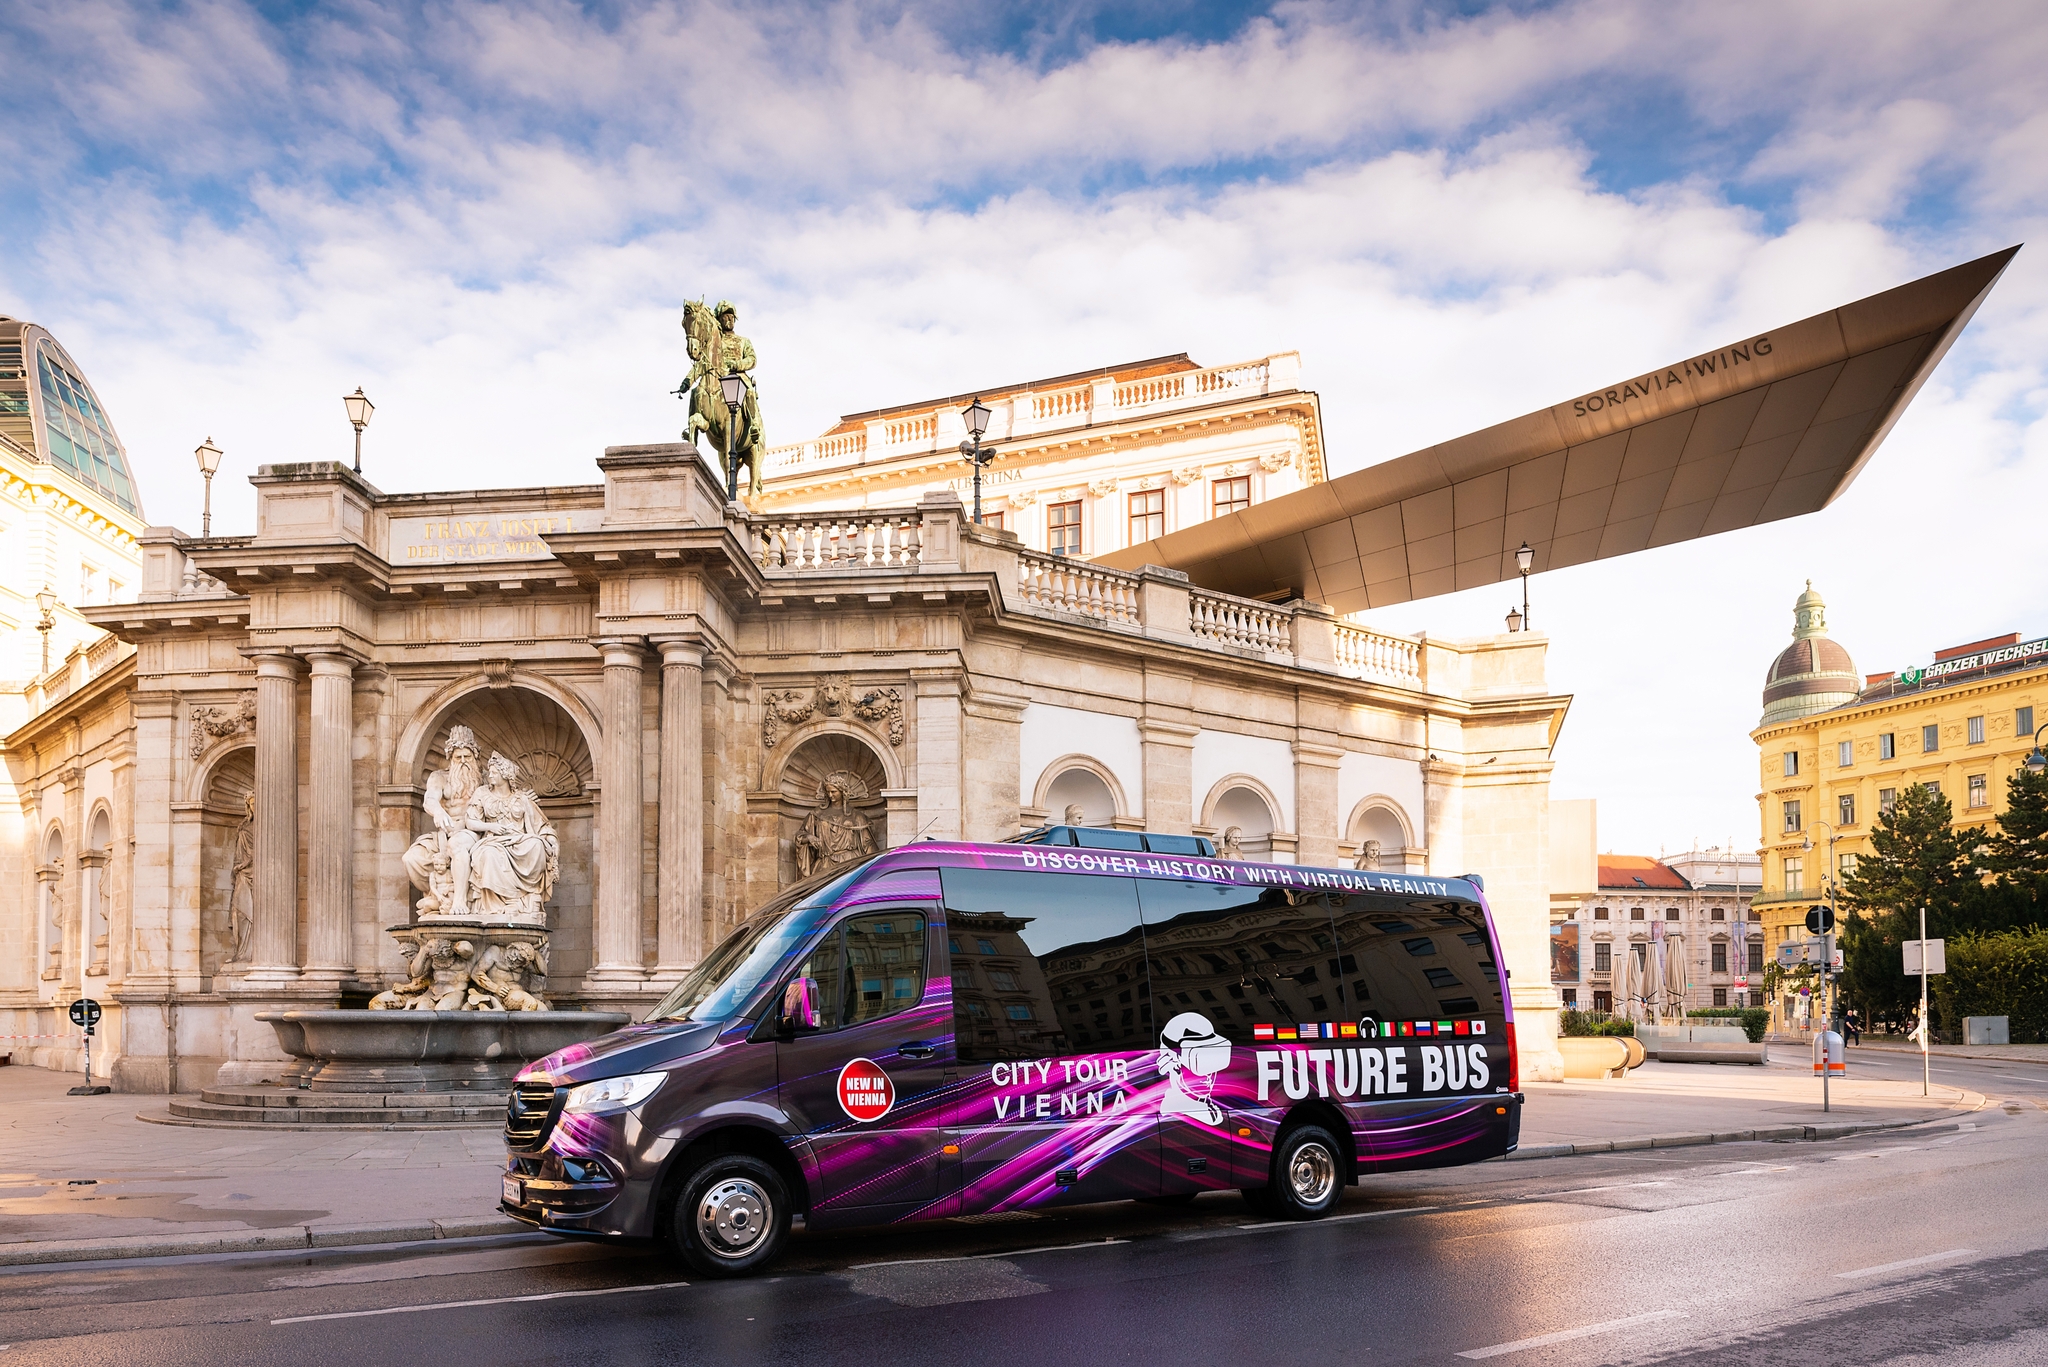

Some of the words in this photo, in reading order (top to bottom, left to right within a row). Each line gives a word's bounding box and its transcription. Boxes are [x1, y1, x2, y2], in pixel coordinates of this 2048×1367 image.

[1573, 370, 1683, 417] SORAVIA
[1693, 337, 1773, 377] WING
[947, 469, 1023, 491] ALBRTINA
[425, 521, 489, 540] FRANZ
[497, 517, 559, 537] JOSEF
[407, 545, 440, 558] DER
[445, 542, 500, 557] STADT
[505, 540, 548, 555] WIEN
[1925, 656, 1979, 678] GRAZER
[1022, 850, 1140, 874] DISCOVER
[1148, 858, 1237, 881] HISTORY
[1243, 867, 1294, 886] WITH
[1298, 871, 1376, 892] VIRTUAL
[1381, 878, 1450, 897] REALITY
[991, 1061, 1052, 1087] CITY
[1059, 1058, 1129, 1084] TOUR
[1255, 1046, 1408, 1101] FUTURE
[1420, 1043, 1490, 1092] BUS
[846, 1077, 872, 1091] NEW
[873, 1077, 885, 1091] IN
[847, 1093, 887, 1107] VIENNA
[993, 1090, 1129, 1119] VIENNA
